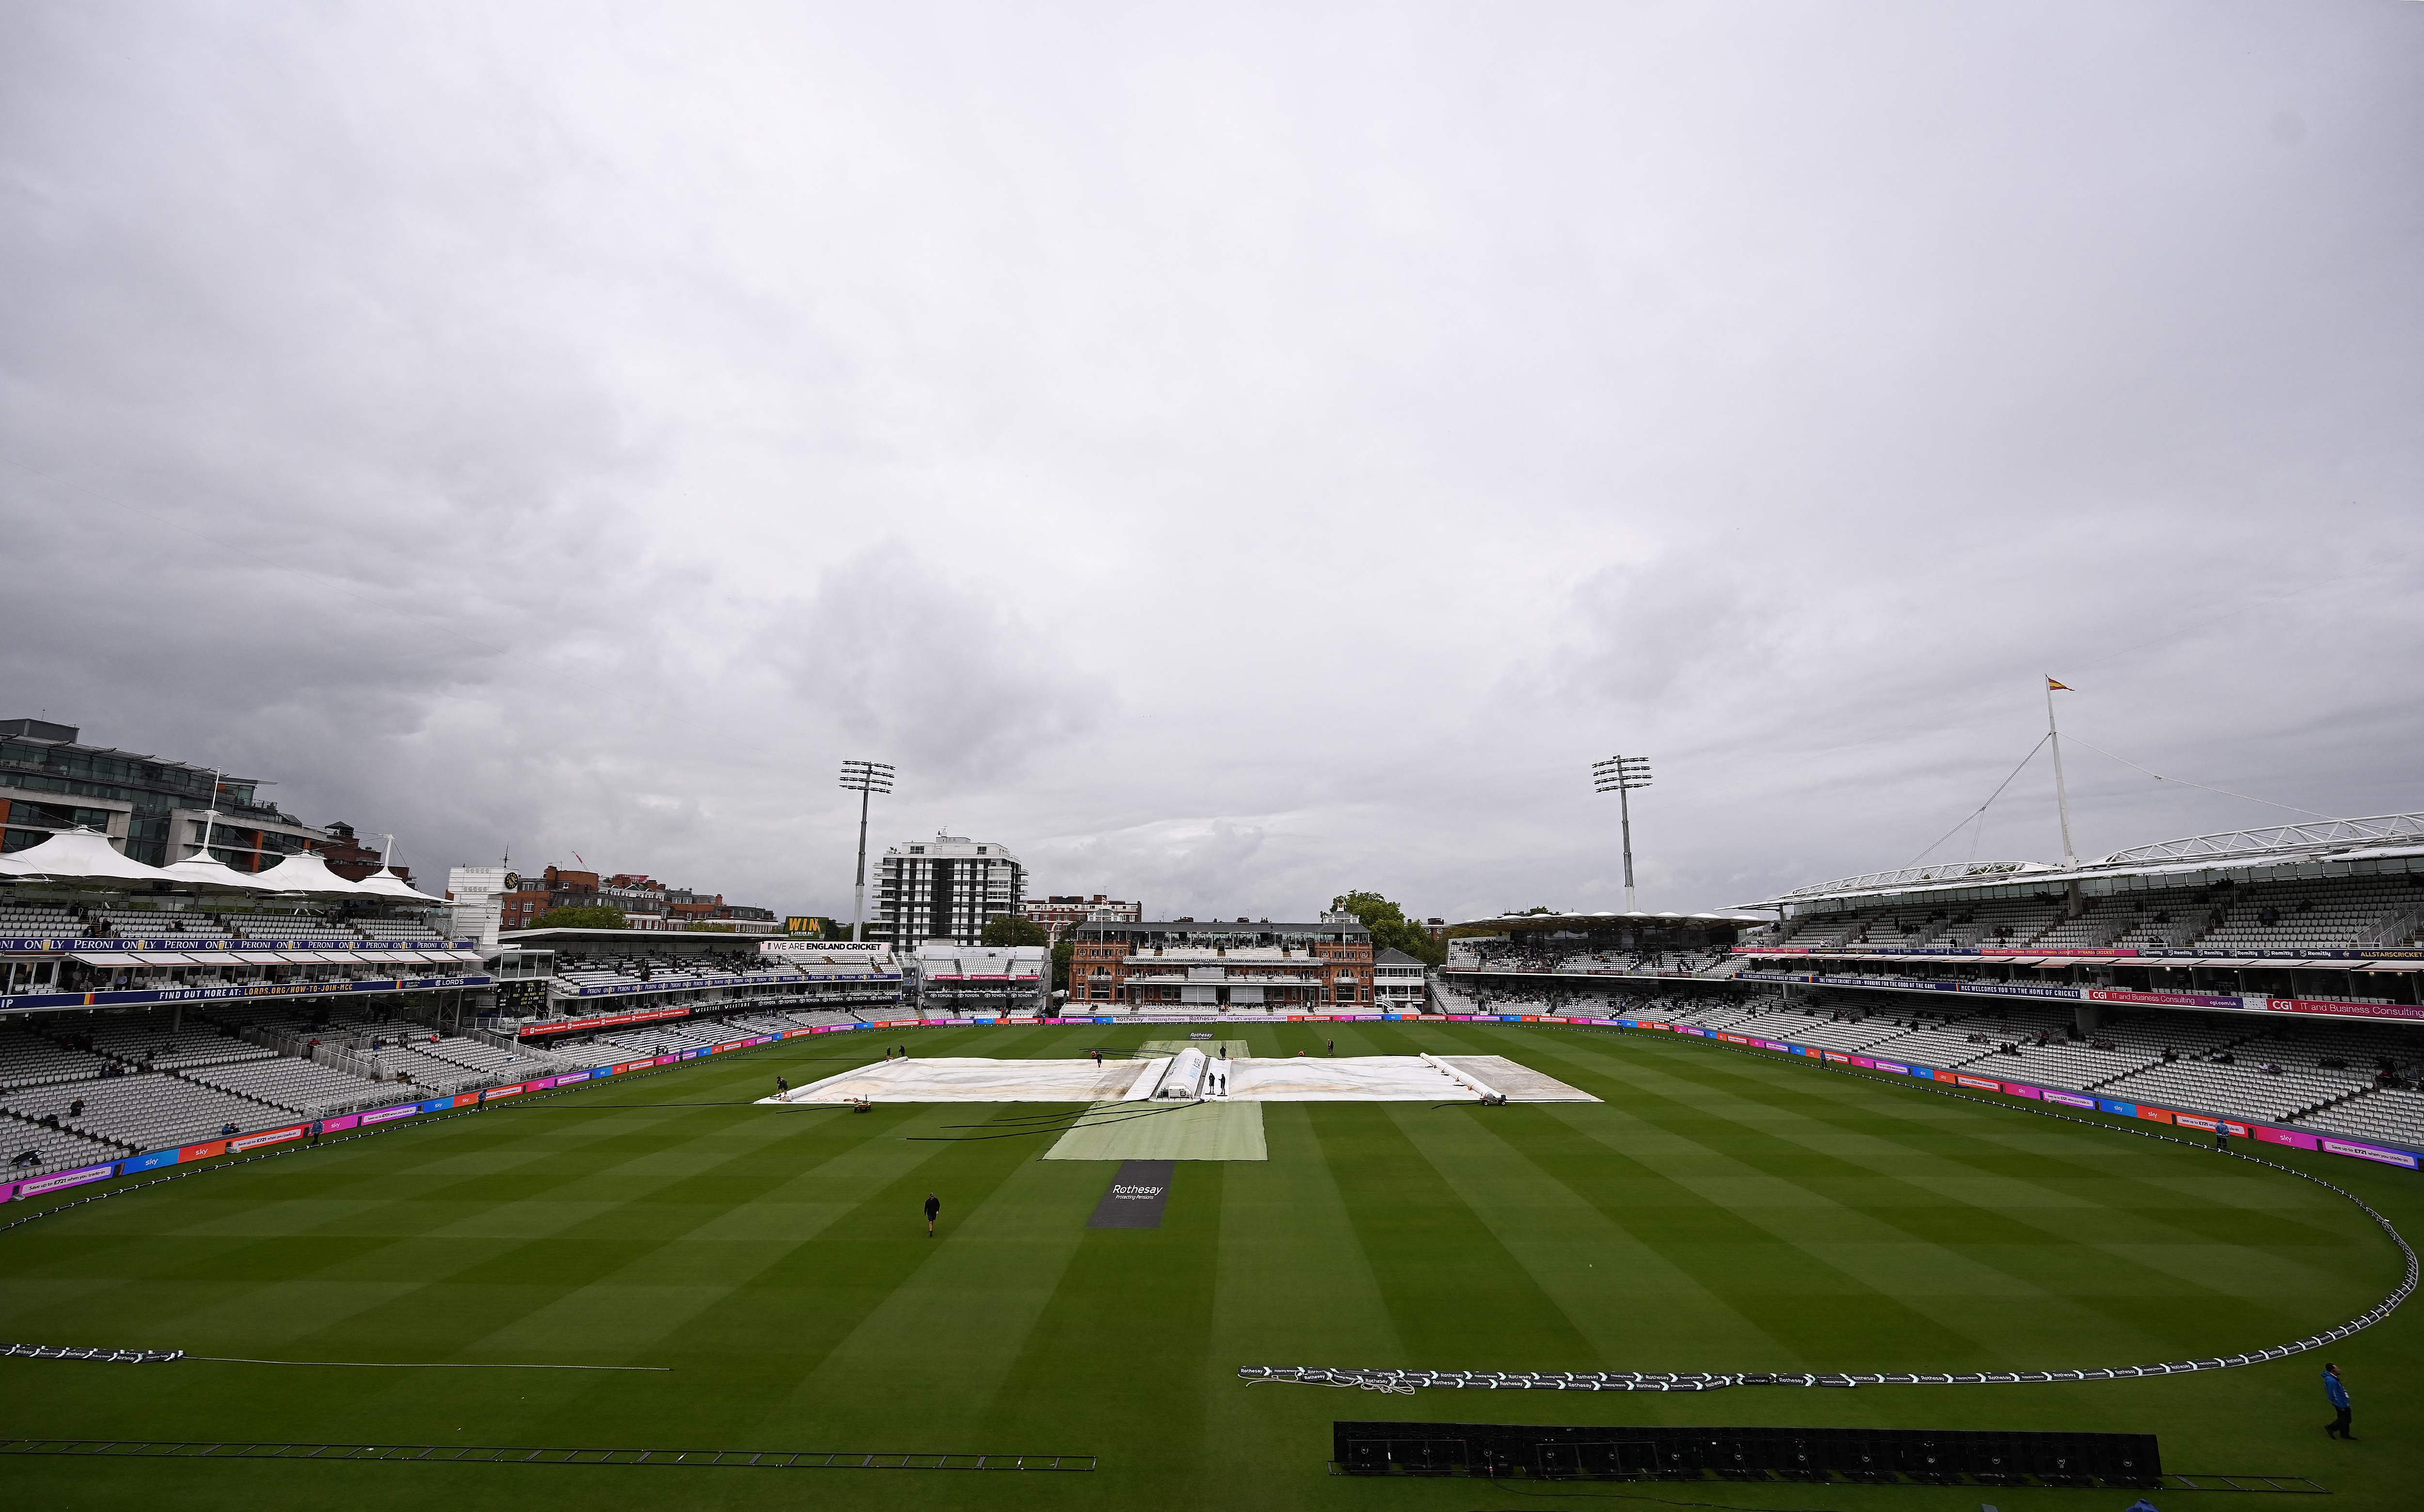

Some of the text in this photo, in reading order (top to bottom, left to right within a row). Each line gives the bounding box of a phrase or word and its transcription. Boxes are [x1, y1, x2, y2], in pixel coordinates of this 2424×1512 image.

[789, 918, 819, 931] WIN
[74, 940, 114, 949] PERONI
[165, 940, 198, 949] PERONI
[159, 991, 180, 999] FIND
[184, 990, 201, 999] OUT
[205, 989, 226, 997] MORE
[244, 984, 353, 995] LORDS.ORG/HOW-TO-JOIN-MCC
[1, 999, 14, 1007] IP
[2132, 994, 2159, 1002] Business
[2160, 995, 2195, 1004] Consulting
[2273, 1001, 2292, 1010] CGI
[2312, 1003, 2327, 1011] and
[2330, 1004, 2370, 1014] Business
[2373, 1006, 2424, 1019] Consulting
[2280, 1134, 2292, 1143] sky
[1113, 1185, 1163, 1195] Rothesay
